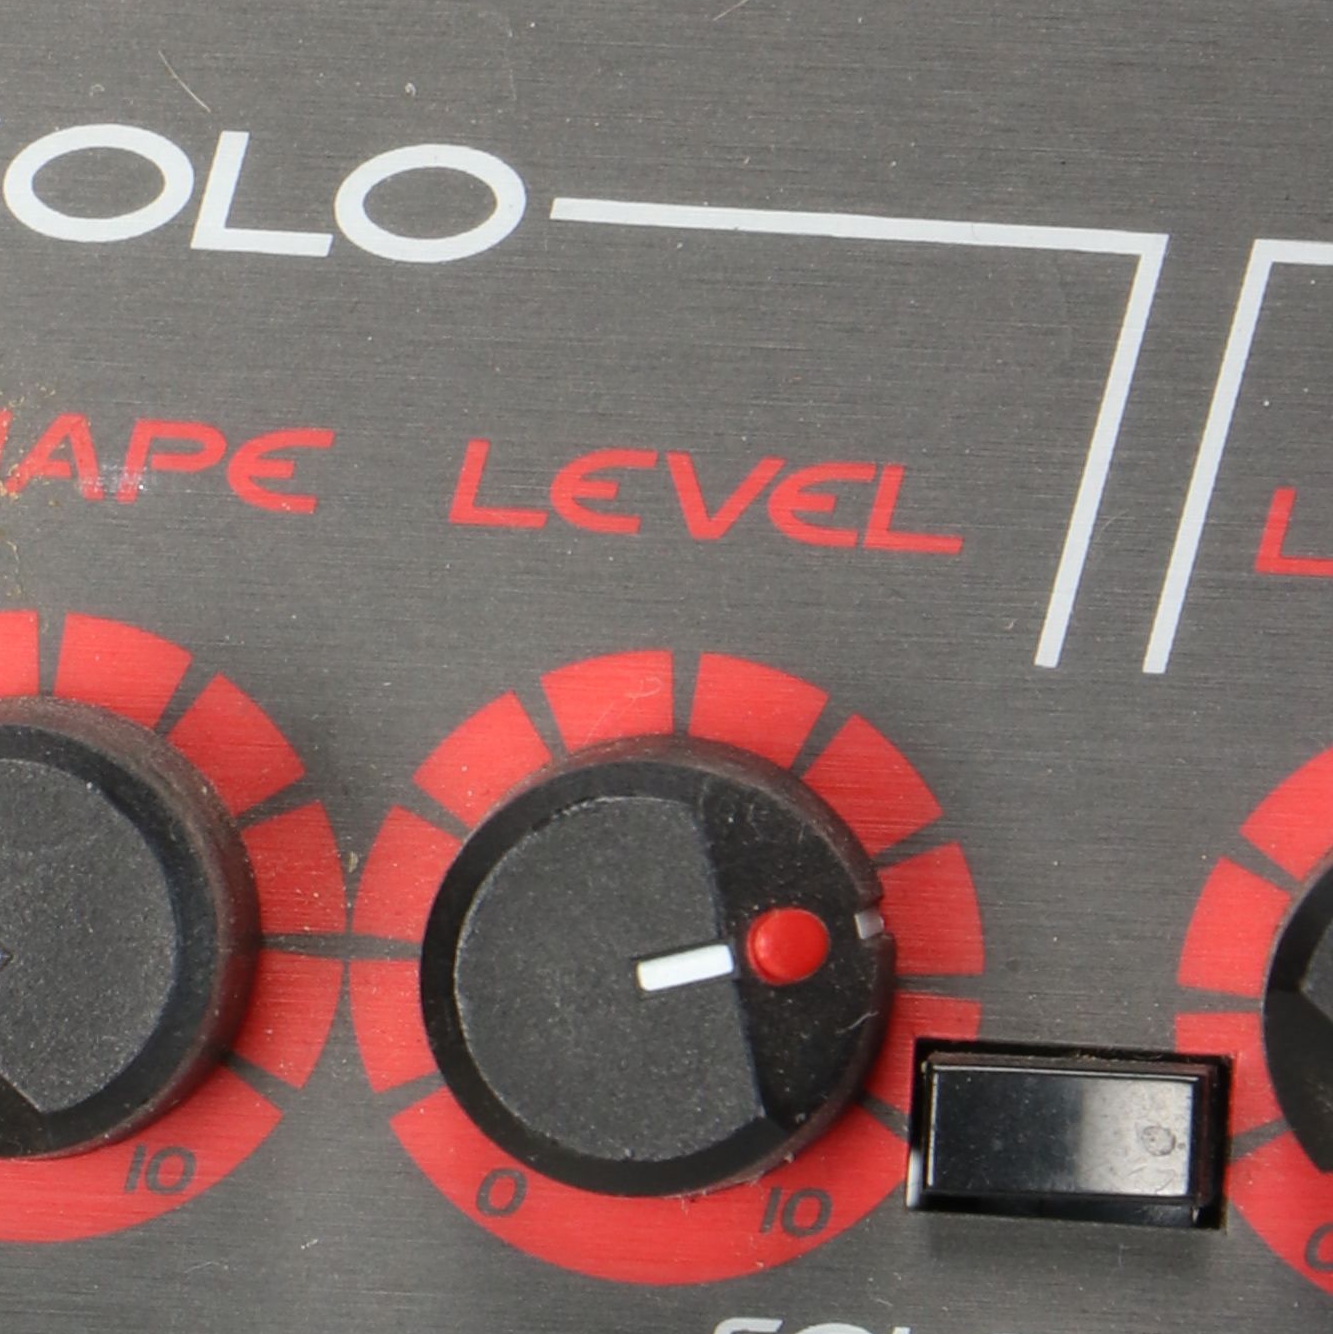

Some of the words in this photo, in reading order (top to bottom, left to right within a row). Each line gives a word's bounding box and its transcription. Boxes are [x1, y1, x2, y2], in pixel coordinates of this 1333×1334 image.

[448, 438, 964, 555] LEVEL
[123, 1145, 196, 1196] 10
[477, 1169, 527, 1216] 0
[760, 1187, 833, 1238] 10
